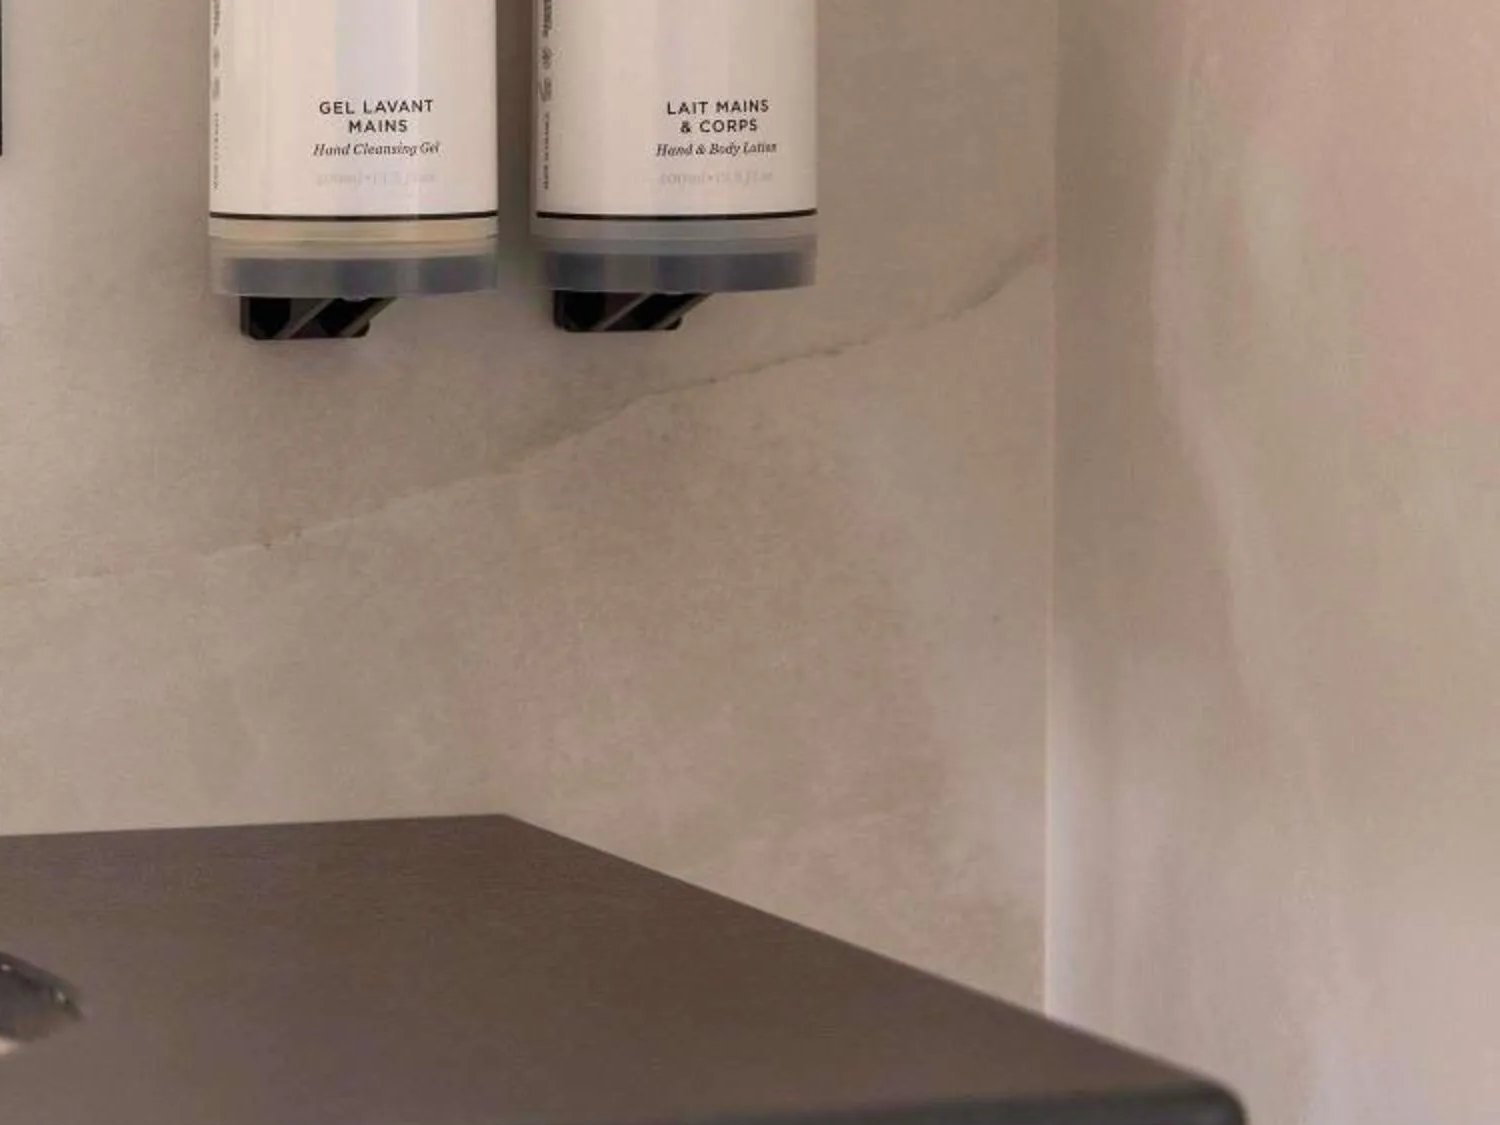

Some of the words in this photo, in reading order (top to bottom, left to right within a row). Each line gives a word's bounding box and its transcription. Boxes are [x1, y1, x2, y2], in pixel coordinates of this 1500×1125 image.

[318, 101, 355, 116] GEL
[362, 99, 434, 114] LAVANT
[666, 101, 708, 116] LAIT
[715, 99, 770, 114] MAINS
[348, 118, 409, 134] MAINS
[679, 120, 692, 135] &
[699, 118, 758, 133] CORPS
[311, 143, 351, 157] Hand
[352, 141, 417, 158] Cleansing
[419, 141, 441, 154] Gel
[655, 143, 693, 157] Hand
[694, 144, 706, 156] &
[709, 142, 741, 158] Body
